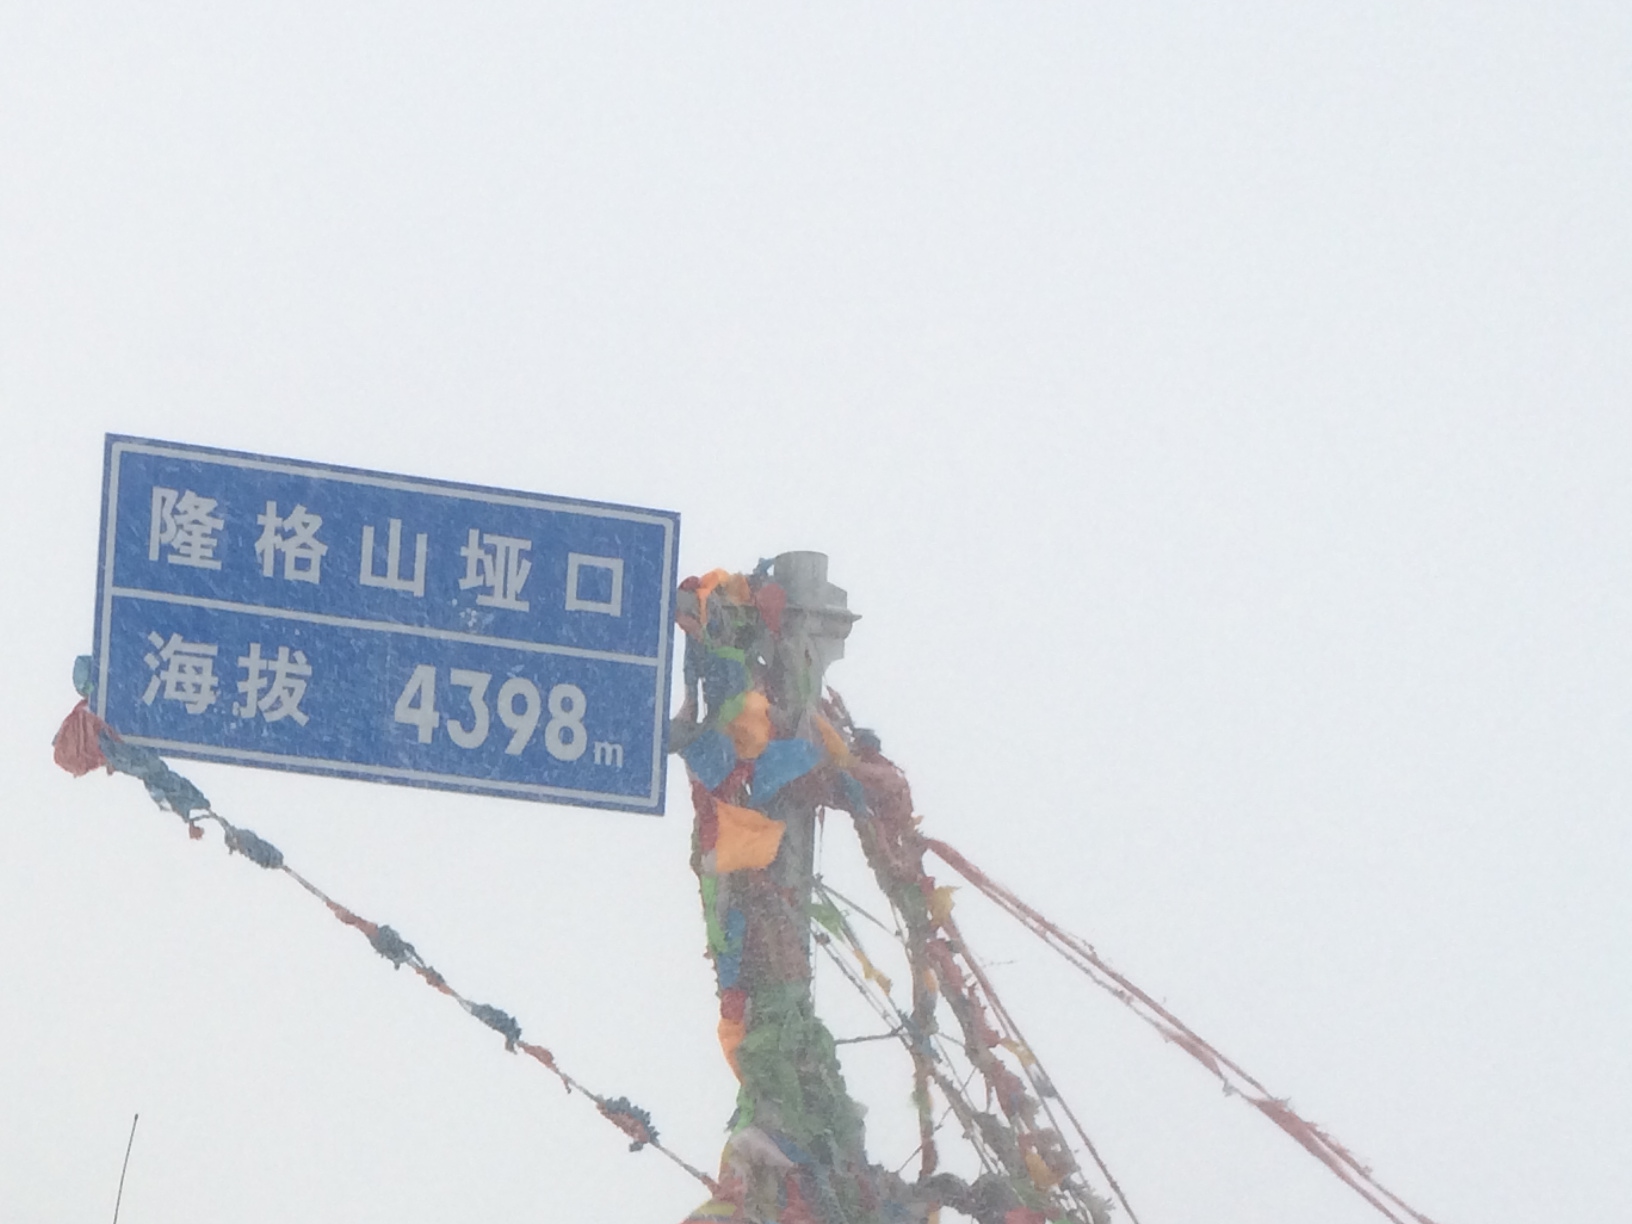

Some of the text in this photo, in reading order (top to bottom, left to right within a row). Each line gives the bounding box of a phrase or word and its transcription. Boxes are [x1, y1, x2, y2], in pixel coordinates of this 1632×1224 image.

[148, 486, 624, 618] 隆格山垭口
[142, 631, 313, 727] 海拔
